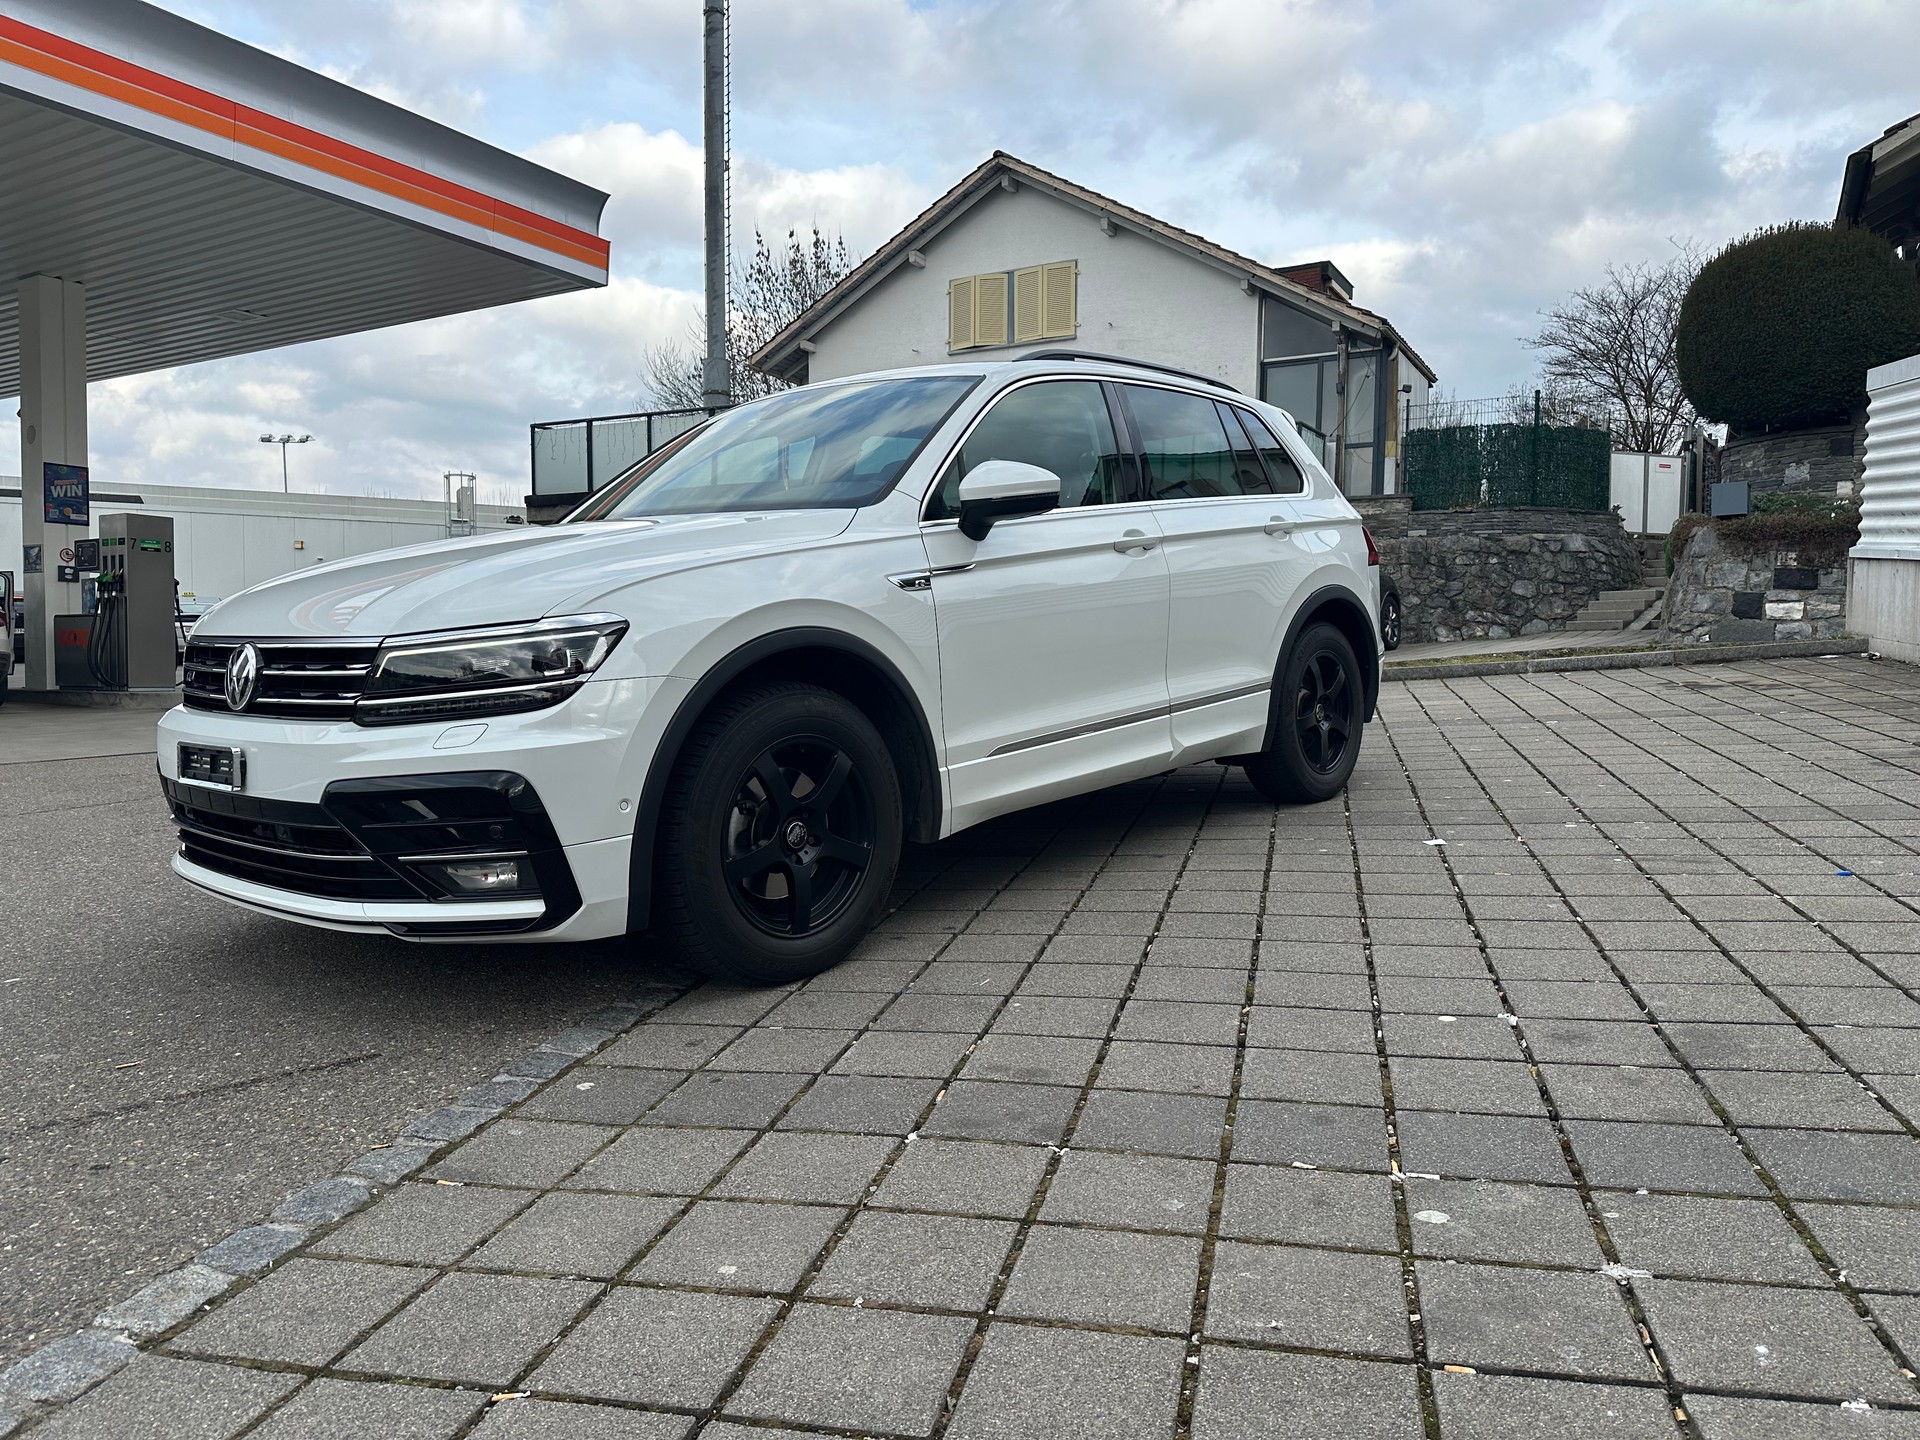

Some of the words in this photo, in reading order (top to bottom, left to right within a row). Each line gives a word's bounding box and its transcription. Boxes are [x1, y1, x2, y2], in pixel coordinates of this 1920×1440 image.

[50, 484, 83, 498] WIN
[130, 537, 137, 550] 7
[164, 541, 172, 553] 8
